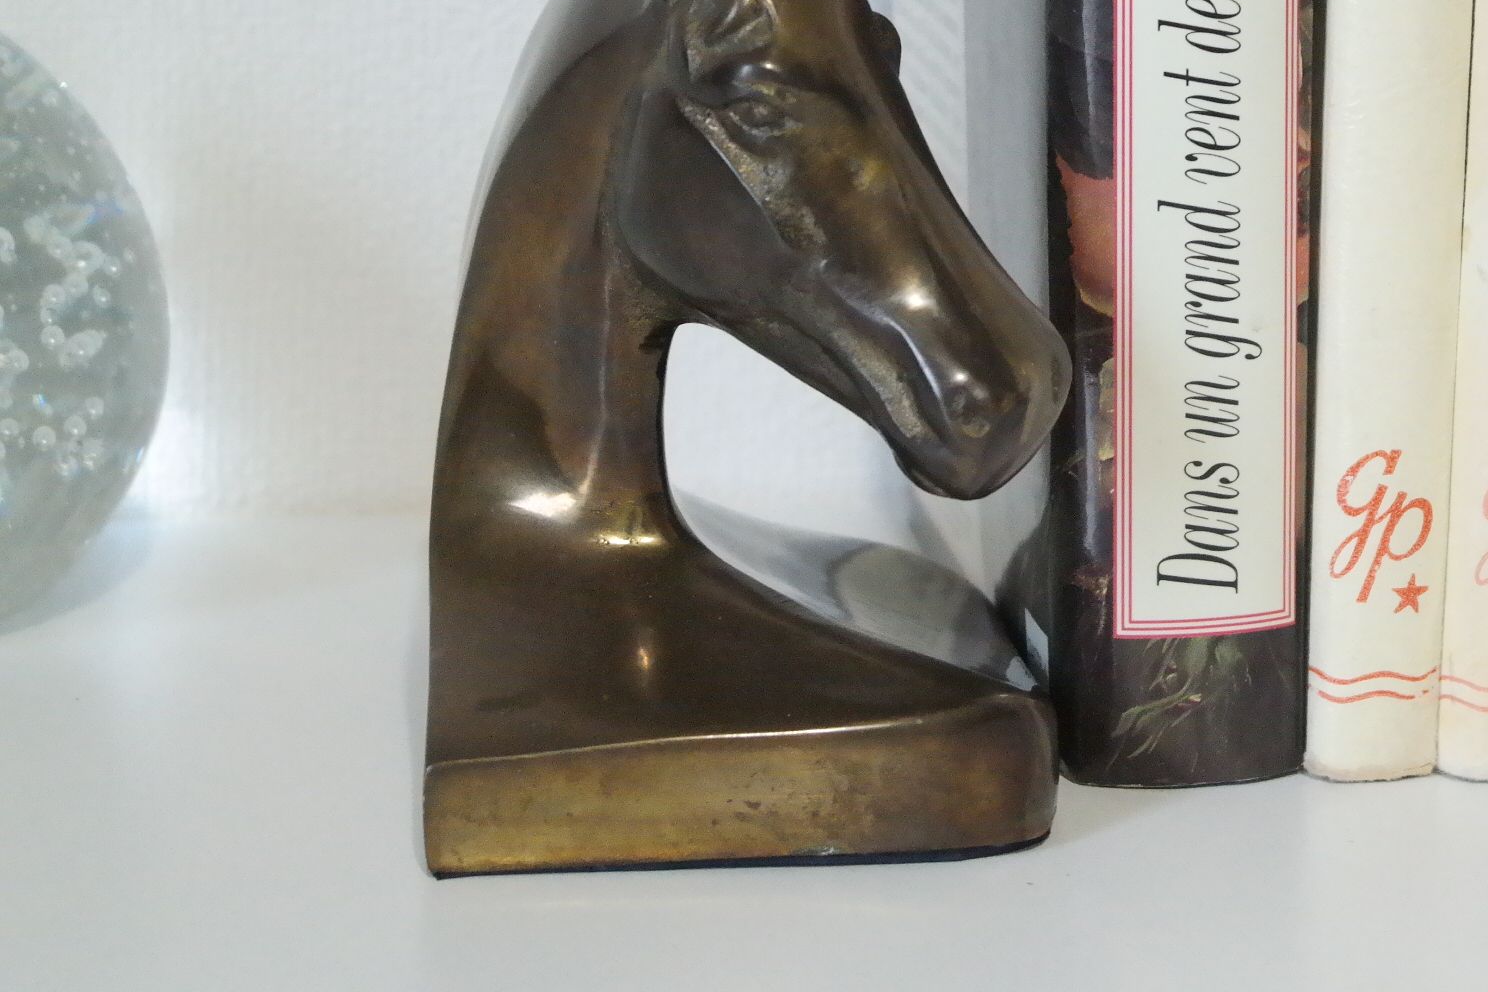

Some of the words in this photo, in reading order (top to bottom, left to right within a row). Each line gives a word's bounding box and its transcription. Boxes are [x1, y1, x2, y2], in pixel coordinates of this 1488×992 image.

[1164, 69, 1242, 185] vent
[1157, 201, 1262, 360] grand
[1184, 375, 1242, 443] un
[1157, 460, 1239, 593] Dans
